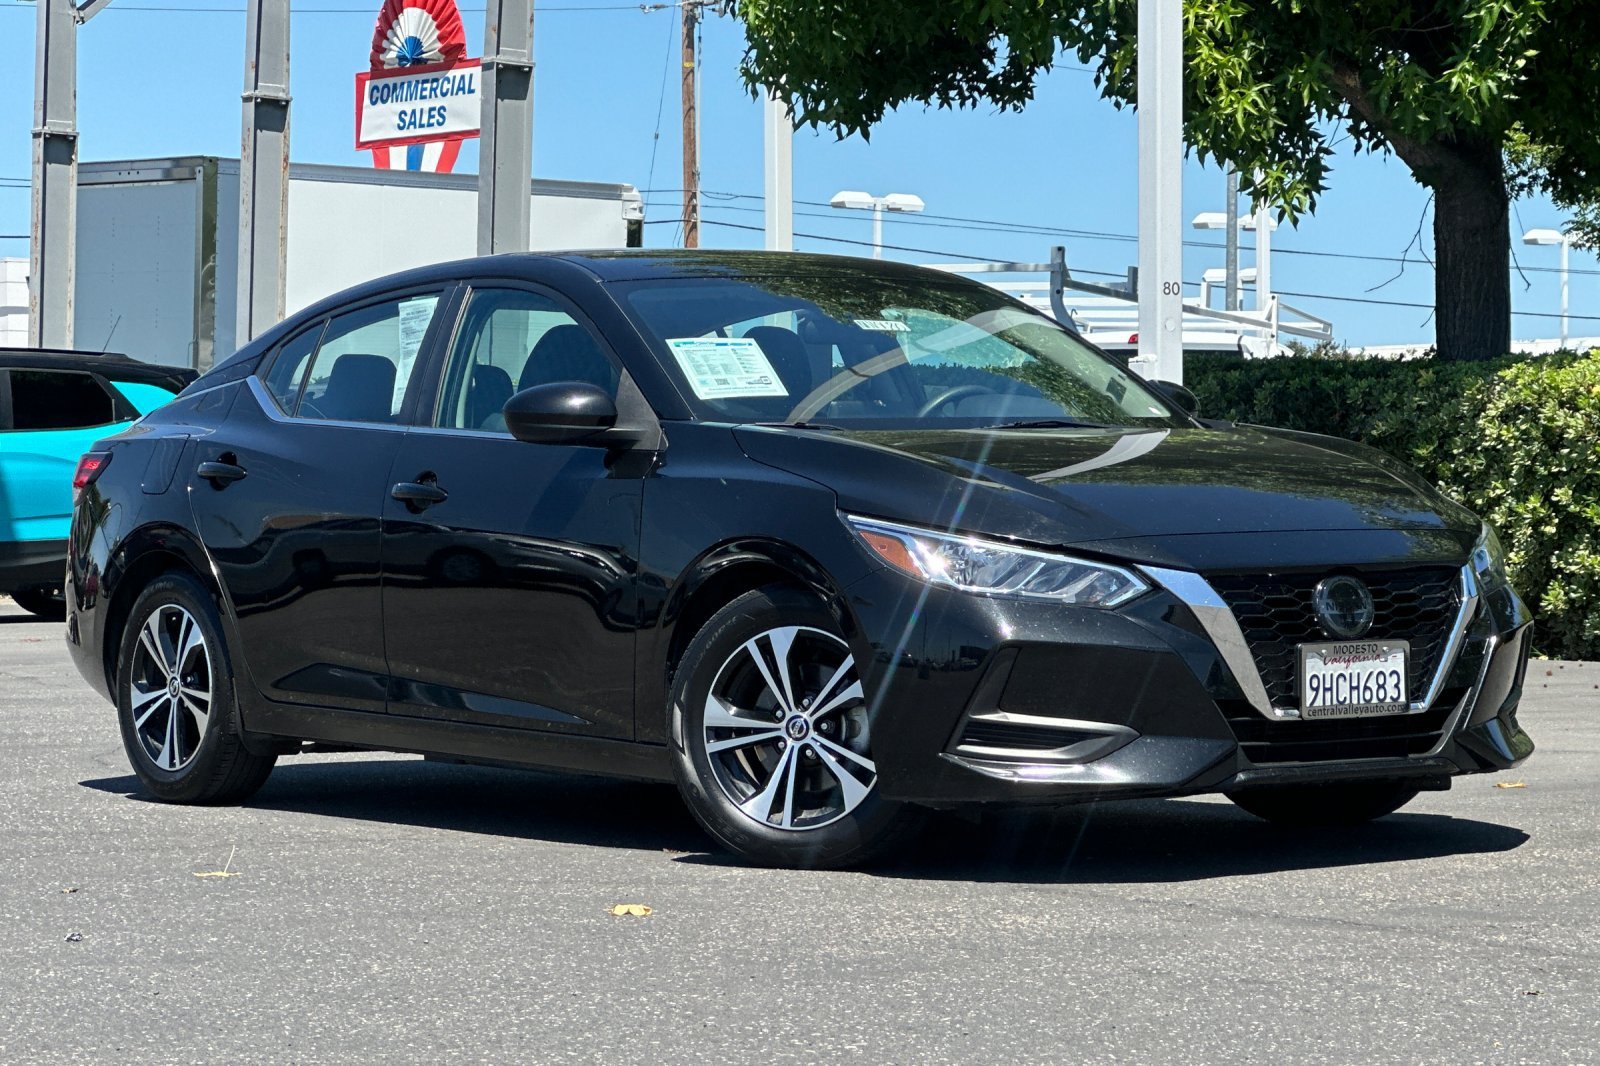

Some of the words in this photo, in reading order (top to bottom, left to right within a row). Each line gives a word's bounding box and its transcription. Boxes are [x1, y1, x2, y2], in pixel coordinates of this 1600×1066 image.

[369, 73, 476, 106] COMMERCIAL
[396, 105, 447, 131] SALES
[1163, 281, 1180, 296] 80
[1333, 643, 1378, 655] MODESTO
[1309, 669, 1401, 707] 9HCH683
[1307, 702, 1406, 717] centralvalleyauto.com
